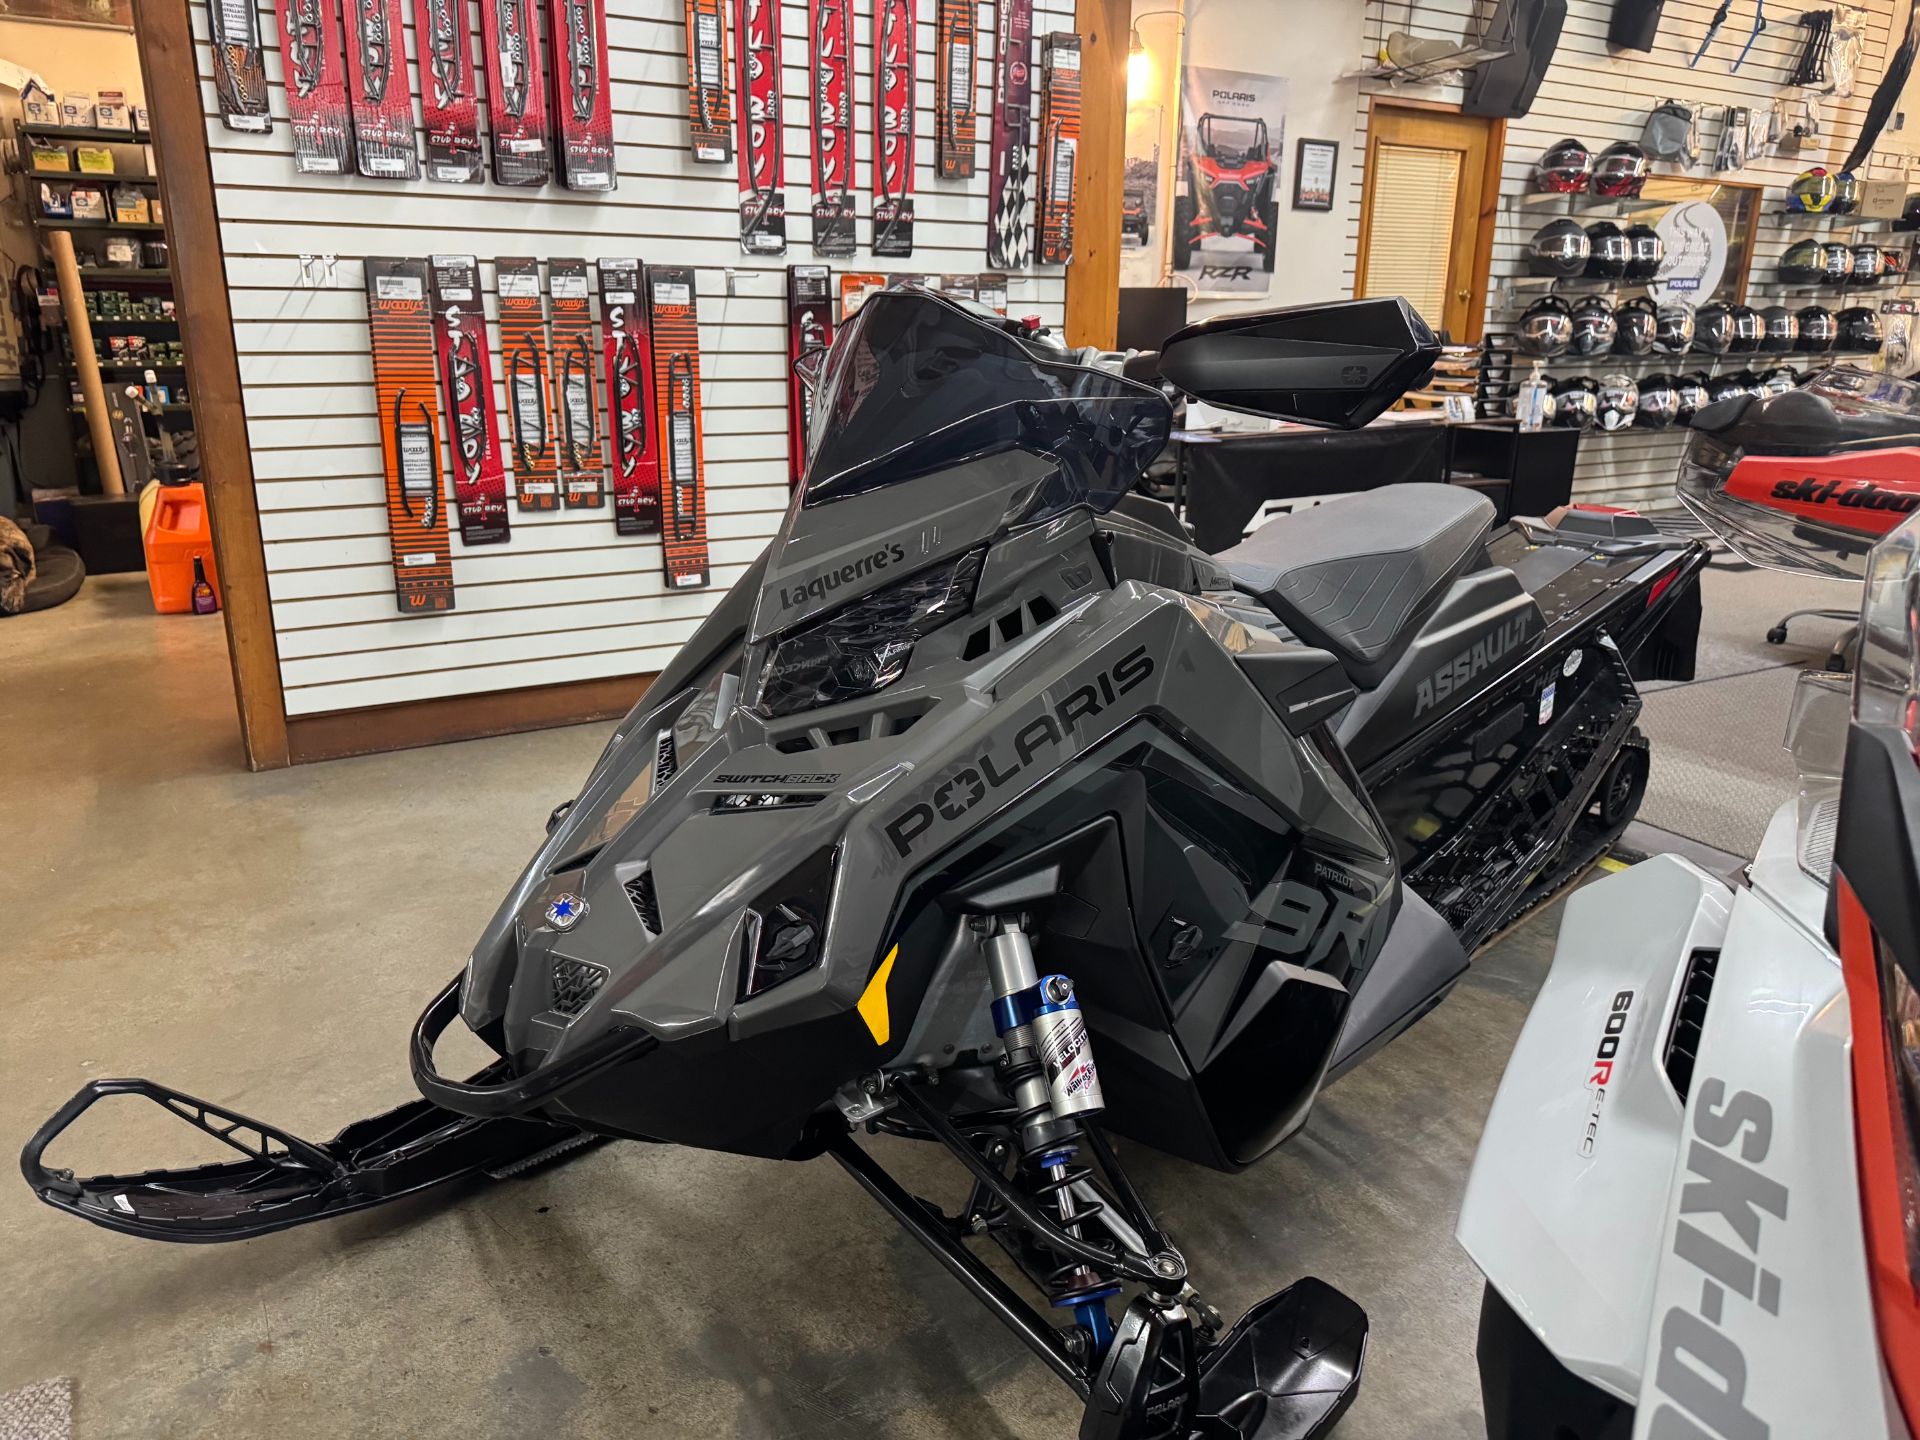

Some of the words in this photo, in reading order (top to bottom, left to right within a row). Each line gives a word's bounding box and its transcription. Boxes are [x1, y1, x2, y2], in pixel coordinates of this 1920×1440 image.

[1212, 89, 1256, 103] POLARIS
[294, 126, 315, 134] STUD
[361, 129, 383, 137] STUD
[430, 135, 452, 144] STUD
[569, 145, 589, 153] STUD
[1198, 265, 1253, 281] RZR
[1669, 280, 1698, 288] POLARIS
[379, 299, 425, 314] woody's
[504, 298, 538, 309] woody's
[555, 298, 585, 311] woody's
[653, 304, 691, 317] woody's
[445, 304, 472, 402] STUD
[609, 306, 631, 398] STUD
[618, 498, 635, 506] STUD
[1770, 477, 1920, 513] ski-doo
[463, 505, 482, 514] STUD
[780, 543, 905, 609] Laquerre's
[1413, 608, 1533, 719] ASSAULT
[884, 644, 1156, 858] POLARIS
[713, 773, 842, 784] SWITCHBACK
[1314, 862, 1355, 888] PATRIOT
[1589, 989, 1635, 1087] 600R
[1581, 1087, 1606, 1154] E-TEC
